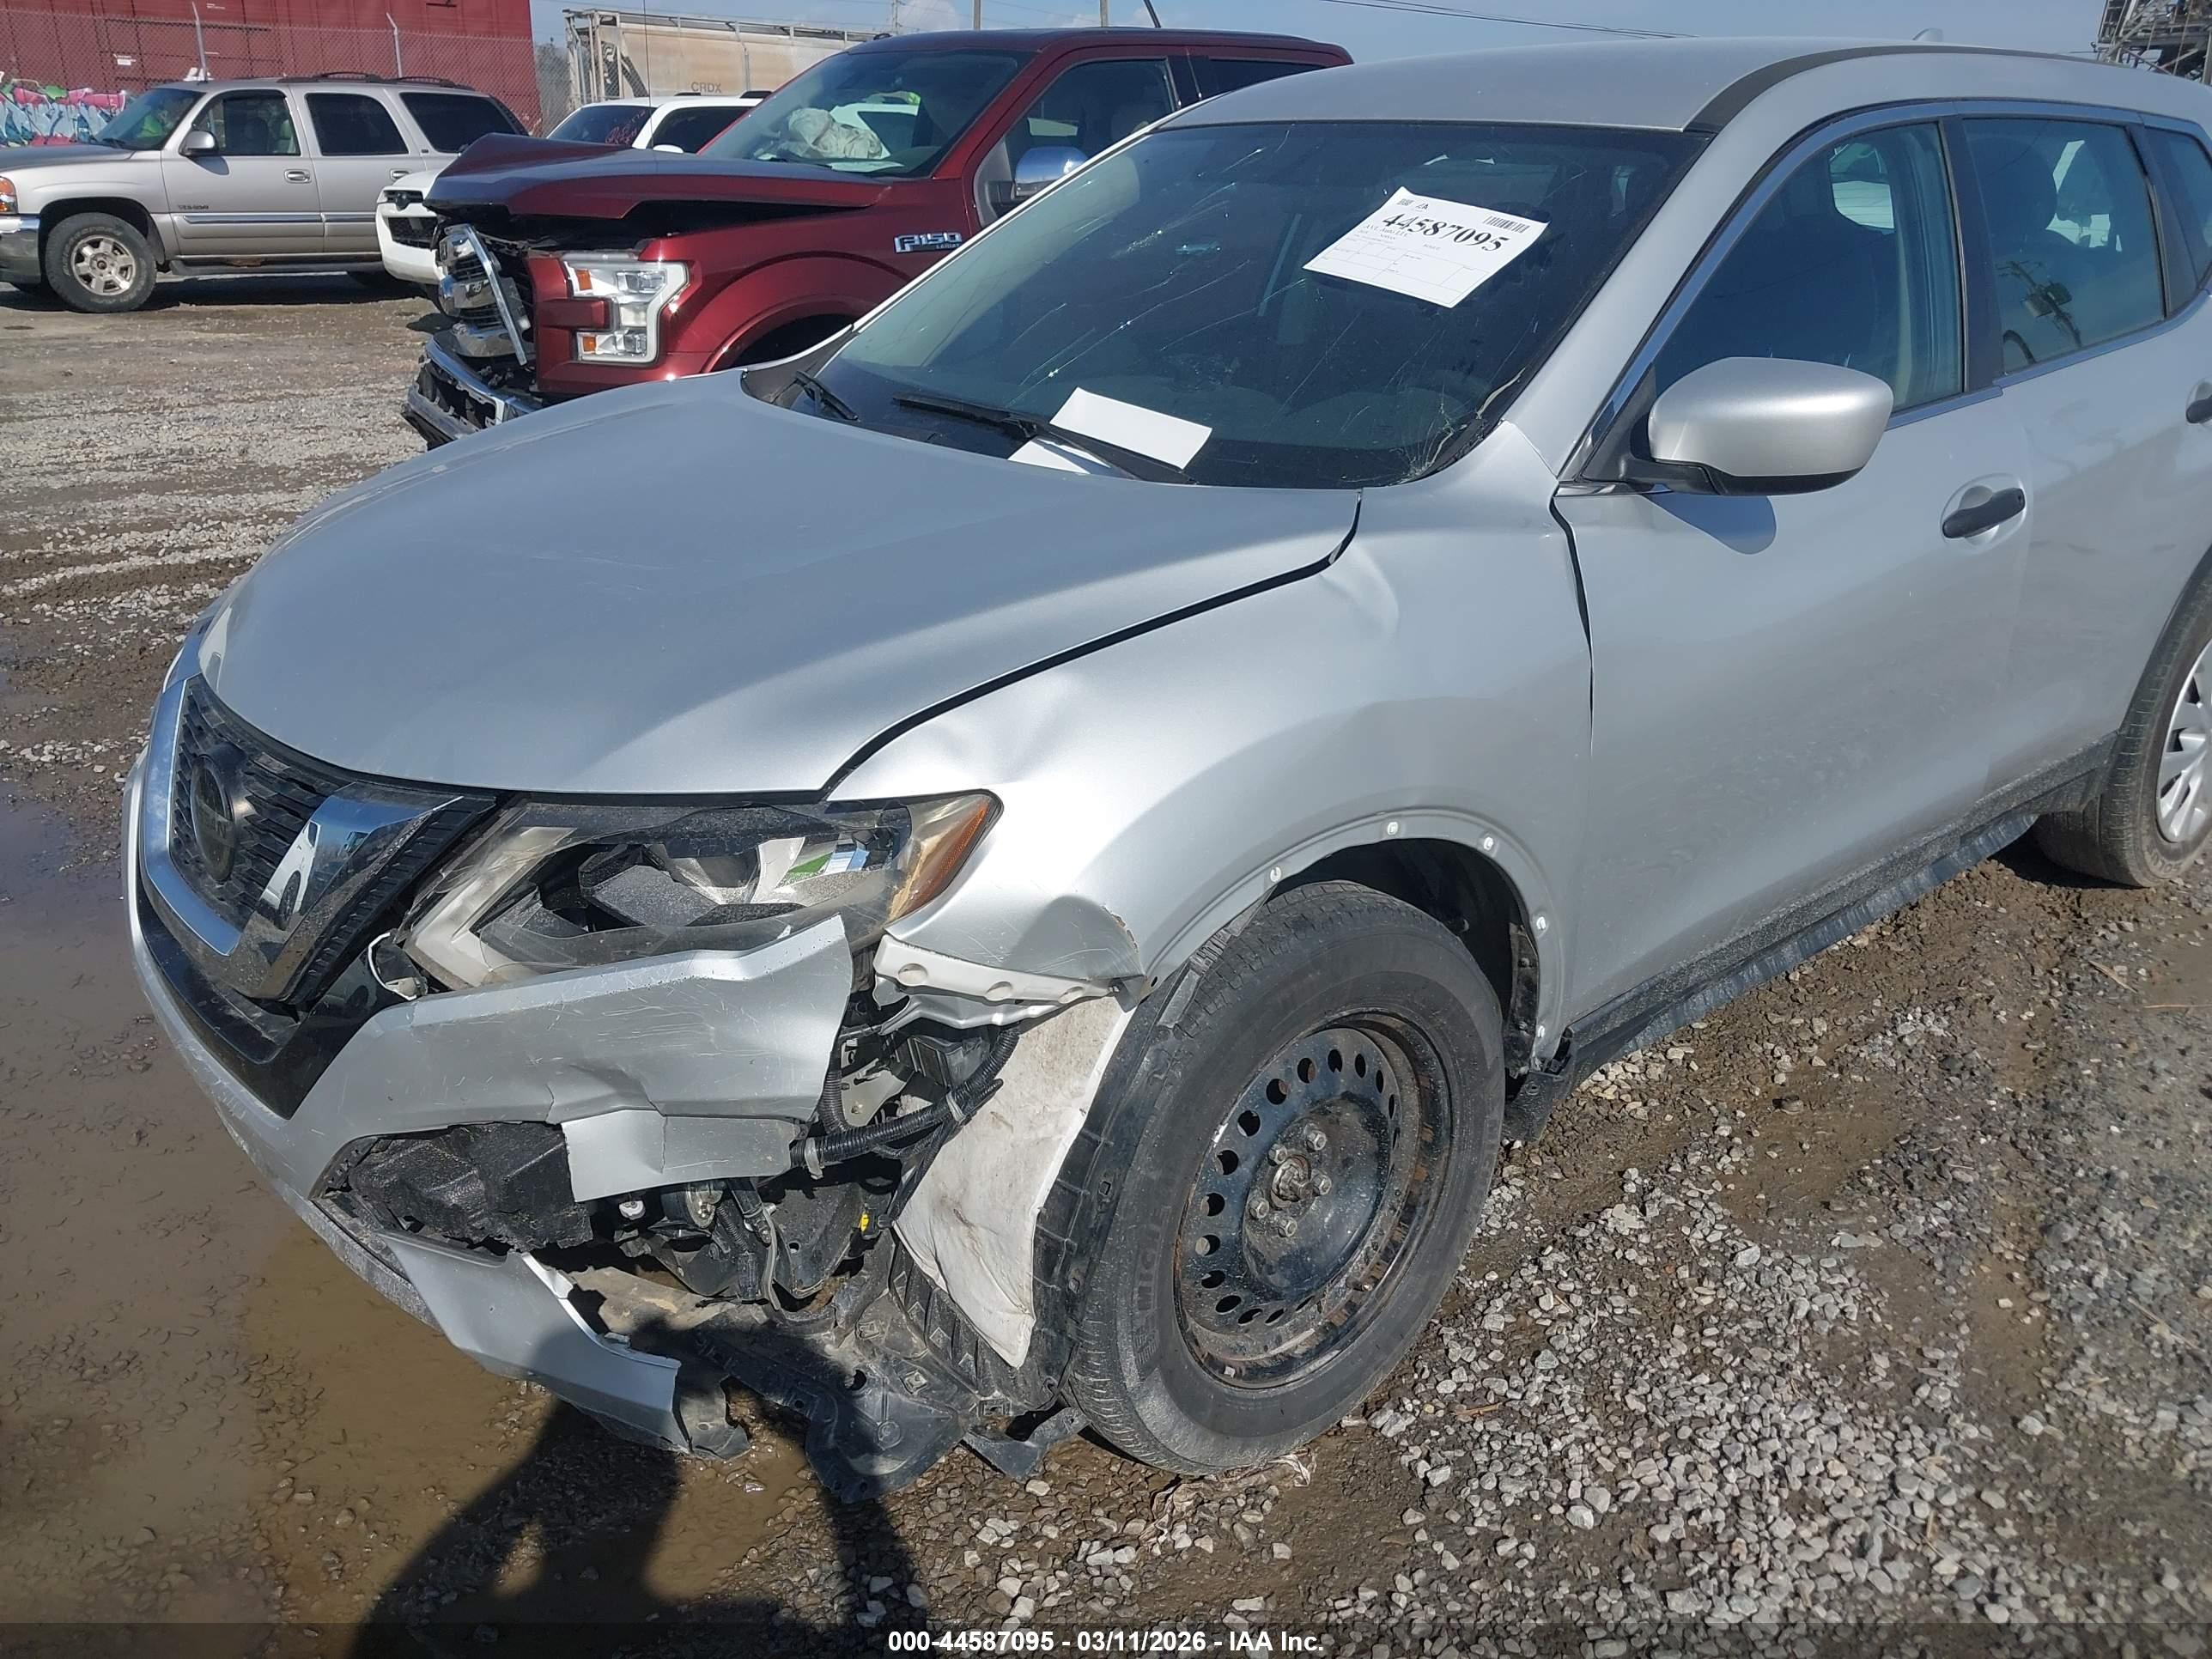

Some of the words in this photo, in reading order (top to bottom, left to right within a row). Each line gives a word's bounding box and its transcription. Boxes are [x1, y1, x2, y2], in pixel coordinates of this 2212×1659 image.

[690, 82, 722, 94] CRDX
[894, 232, 963, 252] F150
[1382, 214, 1510, 252] 44587095
